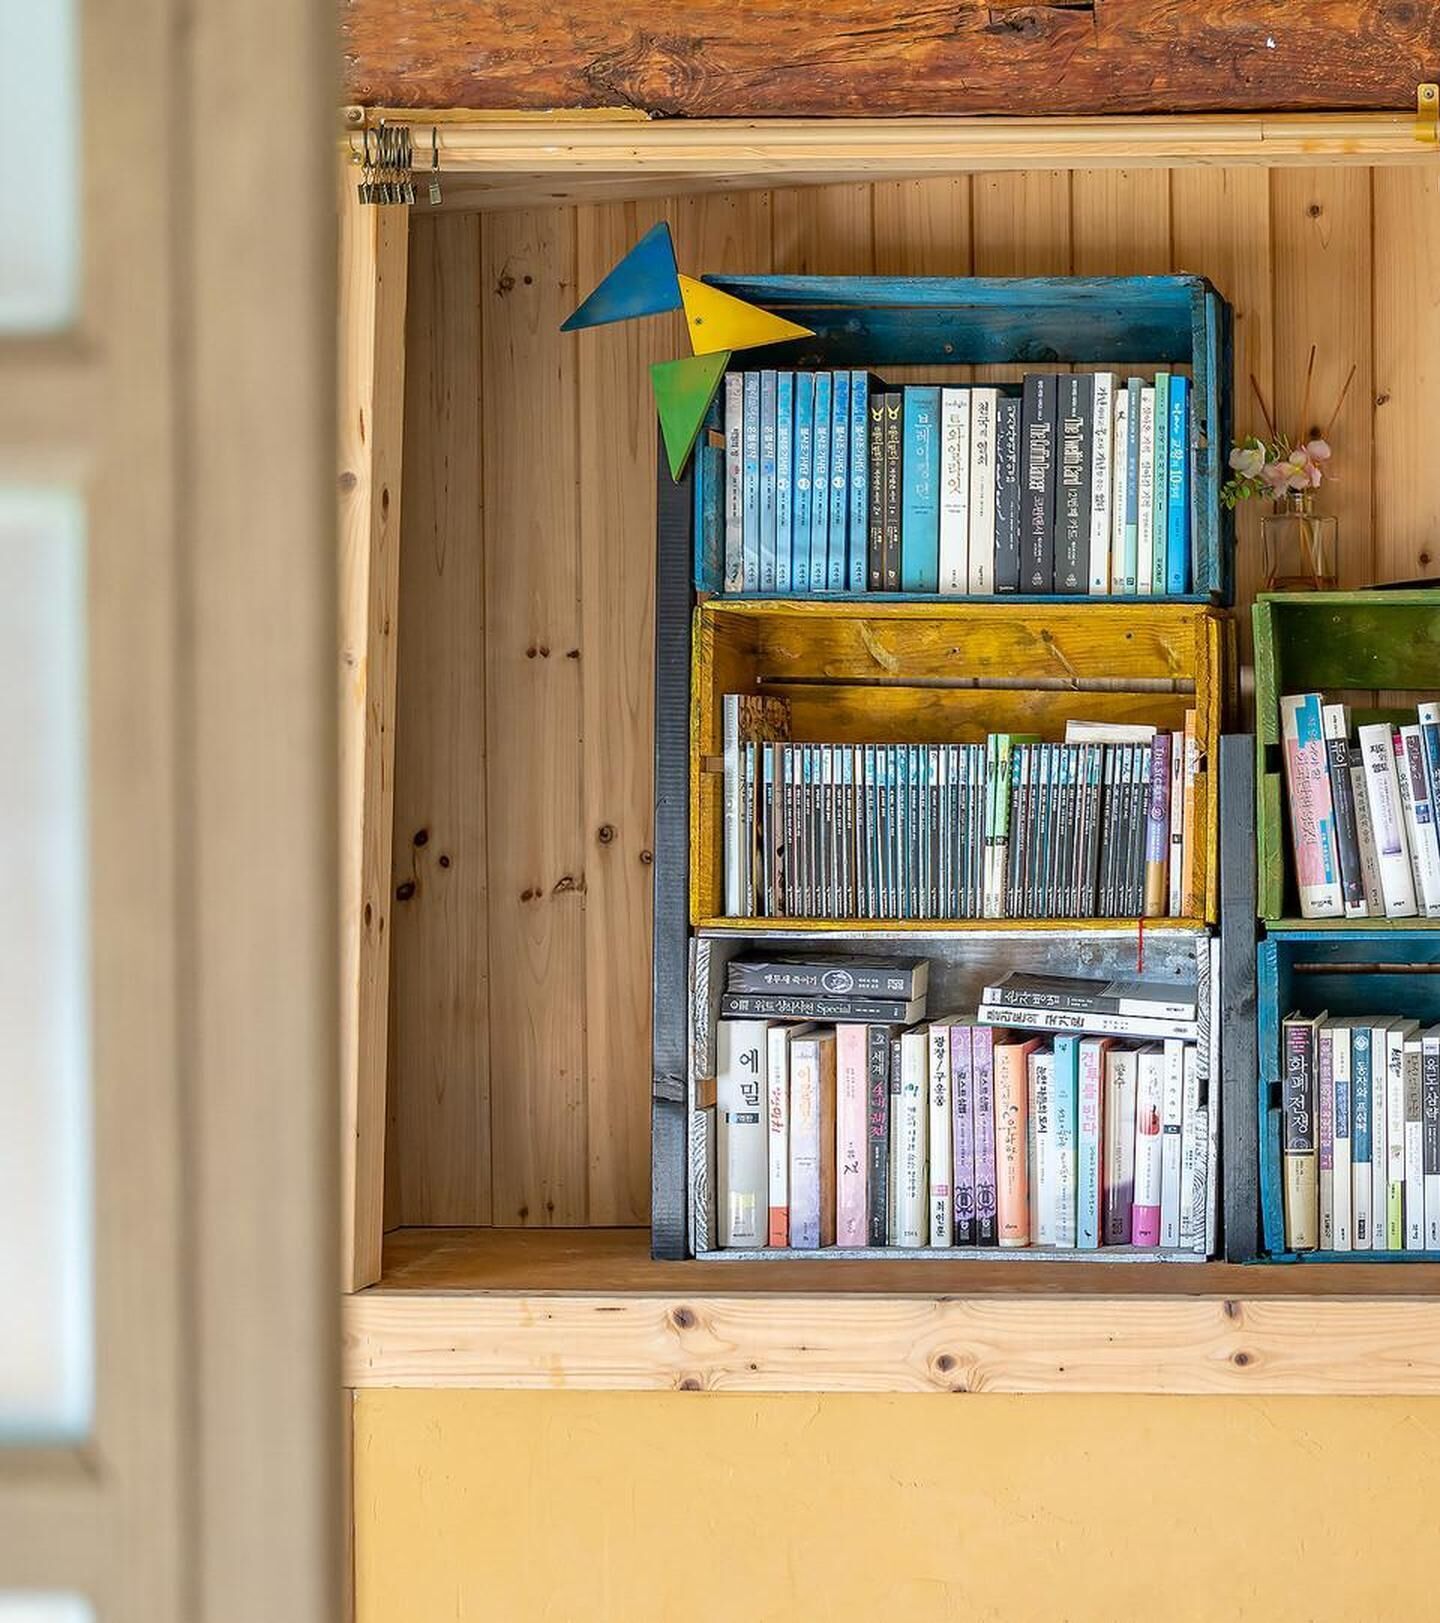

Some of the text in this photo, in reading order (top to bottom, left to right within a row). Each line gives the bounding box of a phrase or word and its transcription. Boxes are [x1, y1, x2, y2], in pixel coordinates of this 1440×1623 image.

[1029, 423, 1050, 439] The
[1063, 417, 1084, 485] The Twelfth Card
[816, 1003, 851, 1014] Special
[1044, 1014, 1085, 1028] 국가론
[740, 1048, 760, 1107] 에밀
[872, 1050, 885, 1075] 세계
[934, 1036, 945, 1107] 광장/구운몽
[1082, 1052, 1097, 1136] 건투를 빈다
[1288, 1057, 1309, 1133] 화폐 전쟁
[1038, 1115, 1048, 1133] 도시
